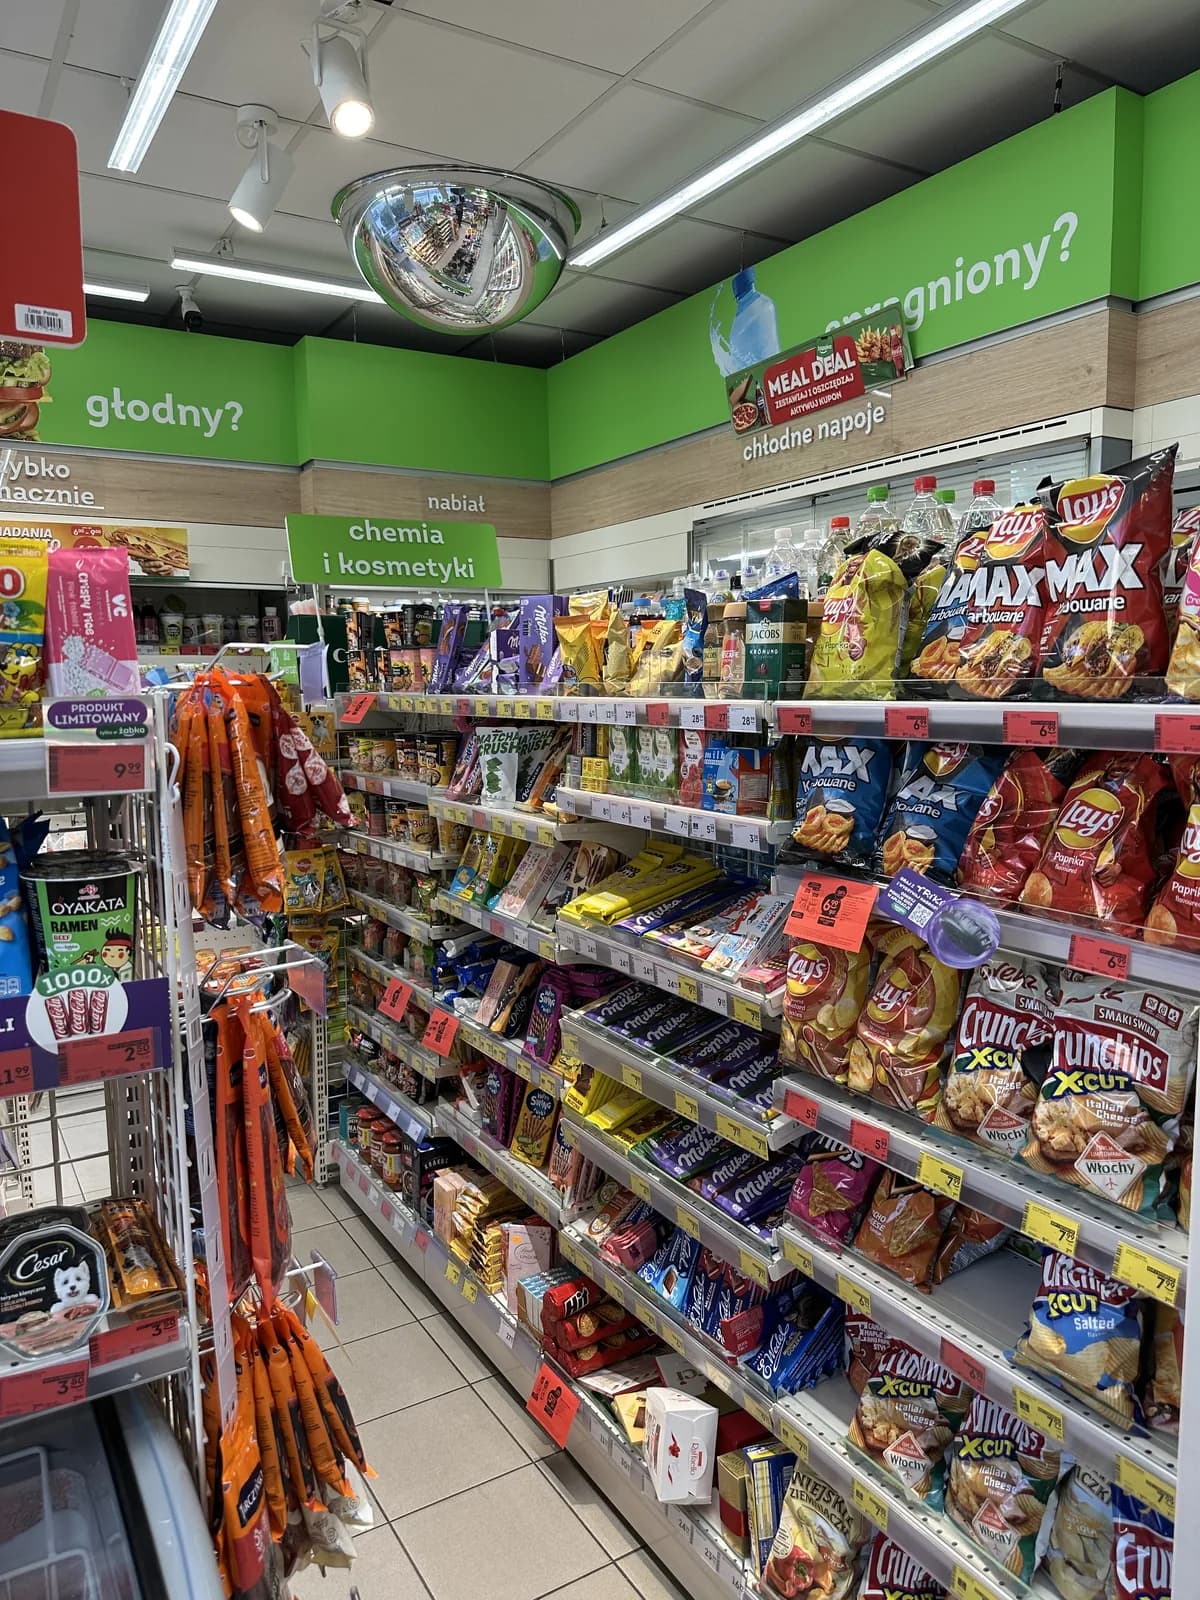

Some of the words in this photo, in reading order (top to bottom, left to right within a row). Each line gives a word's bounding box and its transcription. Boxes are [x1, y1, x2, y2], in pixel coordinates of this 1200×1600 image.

[768, 369, 810, 397] MEAL
[811, 349, 856, 381] DEAL
[775, 390, 808, 409] ZESTAWIAJ
[812, 374, 854, 396] OSZCZĘDZAJ
[790, 400, 819, 417] AKTYWUJ
[819, 391, 842, 406] KUPON
[86, 387, 244, 438] głodny?
[743, 426, 814, 461] chłodne
[818, 401, 885, 440] napoje
[427, 493, 486, 513] nabiał
[1063, 483, 1125, 527] Lay's
[349, 519, 444, 544] chemia
[322, 552, 331, 574] i
[338, 552, 475, 583] kosmetyki
[1046, 543, 1144, 603] MAX
[78, 572, 91, 609] crispy
[83, 612, 95, 636] rice
[534, 604, 549, 644] Milka
[750, 629, 780, 640] JACOBS
[55, 712, 140, 725] LIMITOWANY
[71, 702, 125, 713] PRODUKT
[118, 726, 145, 737] żabka
[478, 742, 520, 756] CRUSH
[1059, 800, 1121, 836] Lay's
[1053, 851, 1085, 866] Paprika
[51, 896, 125, 916] OYAKATA
[636, 899, 682, 927] Milka
[51, 918, 98, 934] RAMEN
[600, 991, 642, 1017] Milka
[624, 1001, 666, 1030] Milka
[647, 1011, 690, 1043] Milka
[1099, 1007, 1132, 1027] SMAKI
[1132, 1014, 1157, 1038] ŚWIATA
[1054, 1030, 1162, 1082] runchips
[729, 1055, 775, 1089] Milka
[1086, 1099, 1124, 1112] Italian
[1096, 1110, 1138, 1124] Cheese
[986, 1128, 1028, 1143] Włochy
[678, 1135, 722, 1167] Milka
[712, 1152, 750, 1184] Milka
[1086, 1161, 1135, 1175] Włochy
[735, 1165, 783, 1203] Milka
[16, 1248, 69, 1280] Cesar
[563, 1286, 590, 1316] Hit
[1074, 1317, 1116, 1331] Salted
[889, 1453, 928, 1473] Włochy
[979, 1522, 1013, 1545] Włochy
